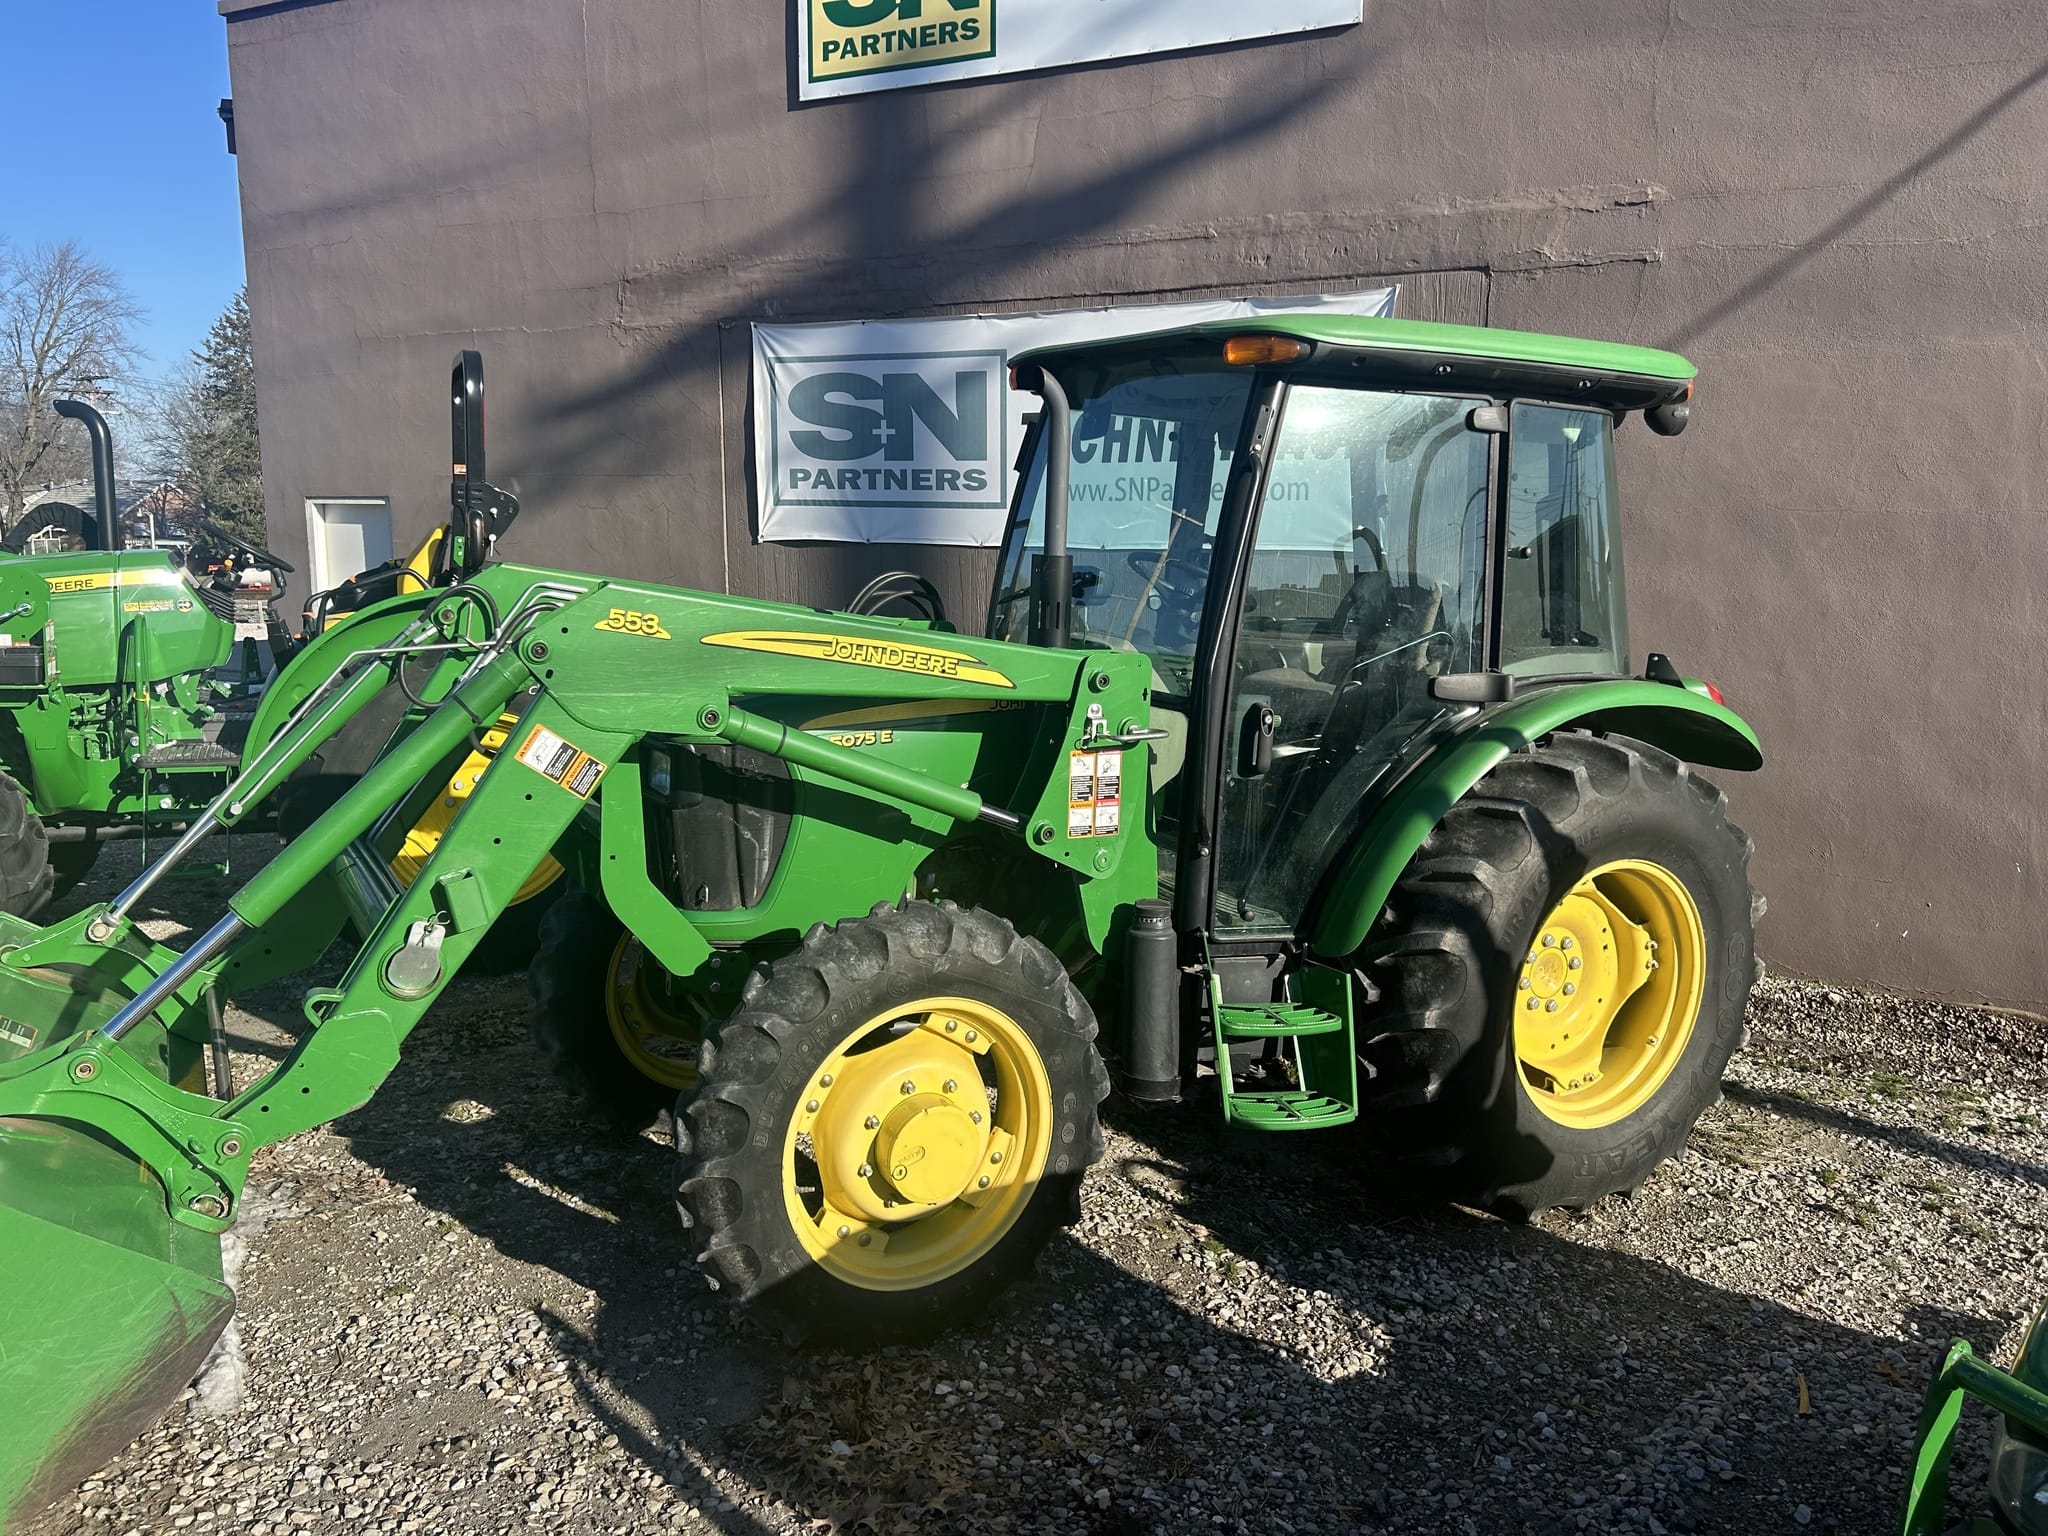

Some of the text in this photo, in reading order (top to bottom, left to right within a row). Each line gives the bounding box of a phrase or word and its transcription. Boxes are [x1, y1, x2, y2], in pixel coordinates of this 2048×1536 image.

[822, 18, 980, 62] PARTNERS
[789, 468, 988, 491] PARTNERS
[608, 608, 659, 635] 553
[829, 729, 893, 747] 5075 E
